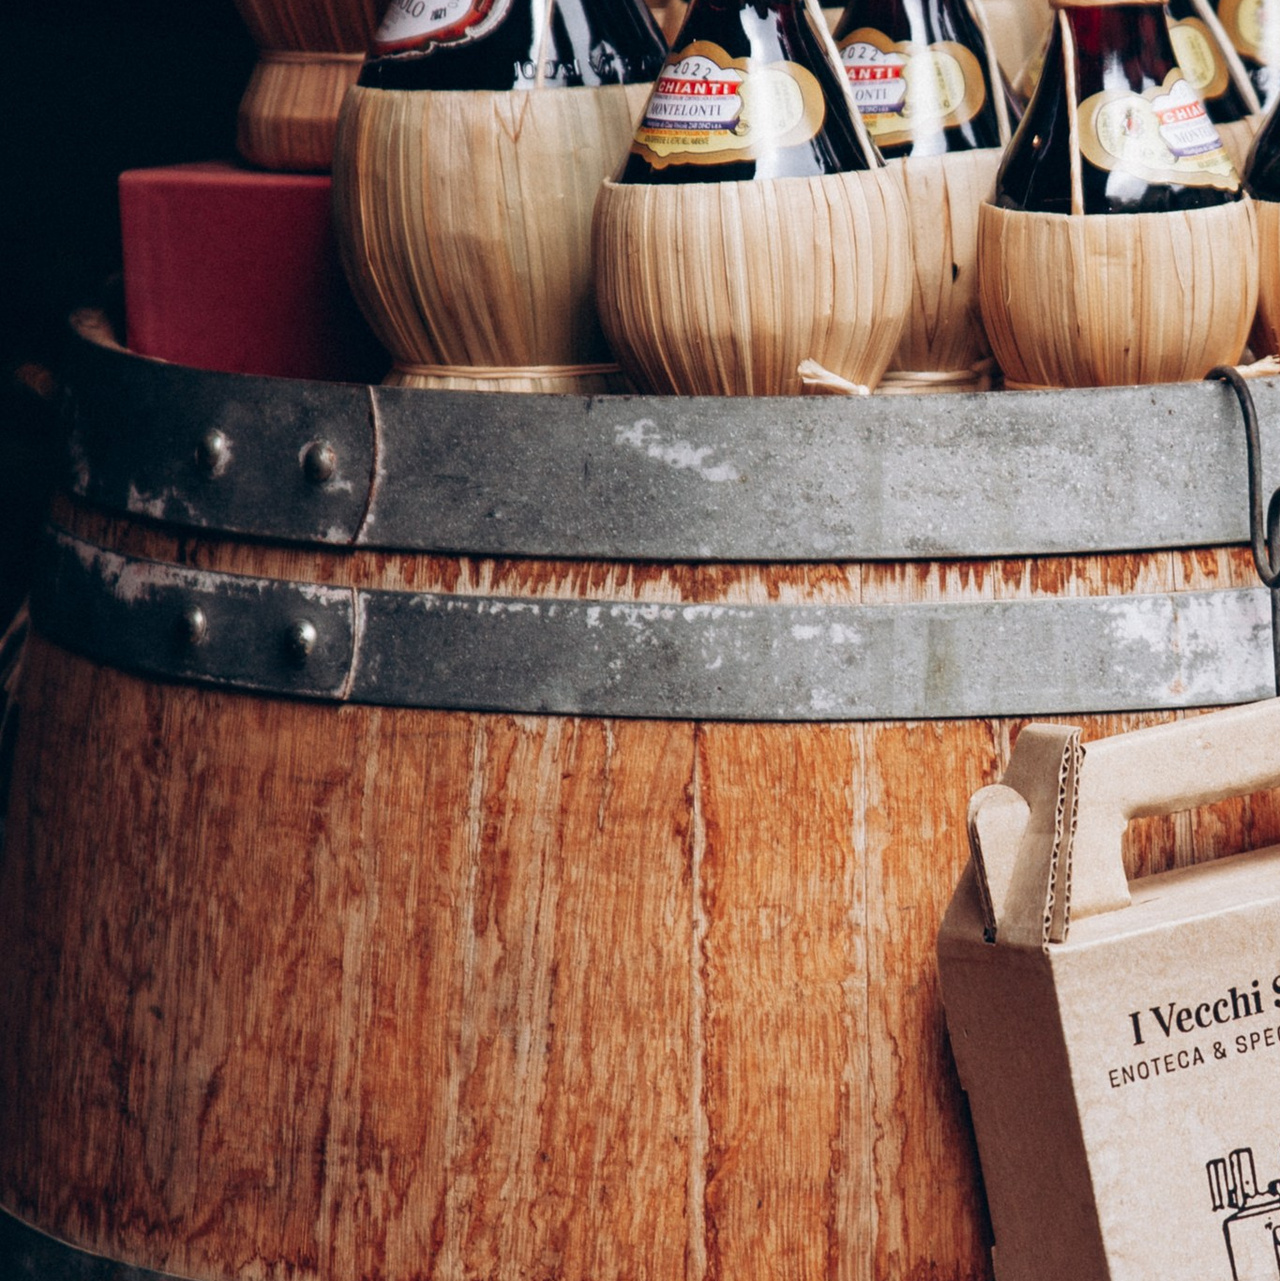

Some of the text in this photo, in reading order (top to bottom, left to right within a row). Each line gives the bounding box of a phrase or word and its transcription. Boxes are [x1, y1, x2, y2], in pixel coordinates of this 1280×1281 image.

[673, 61, 712, 80] 2022
[848, 67, 894, 80] ANTI
[658, 81, 729, 95] CHIANTI
[651, 103, 721, 117] MONTELONTI
[1128, 1011, 1146, 1046] I
[1150, 980, 1264, 1039] Vecchi
[1108, 1045, 1205, 1089] ENOTECA
[1212, 1040, 1228, 1060] &
